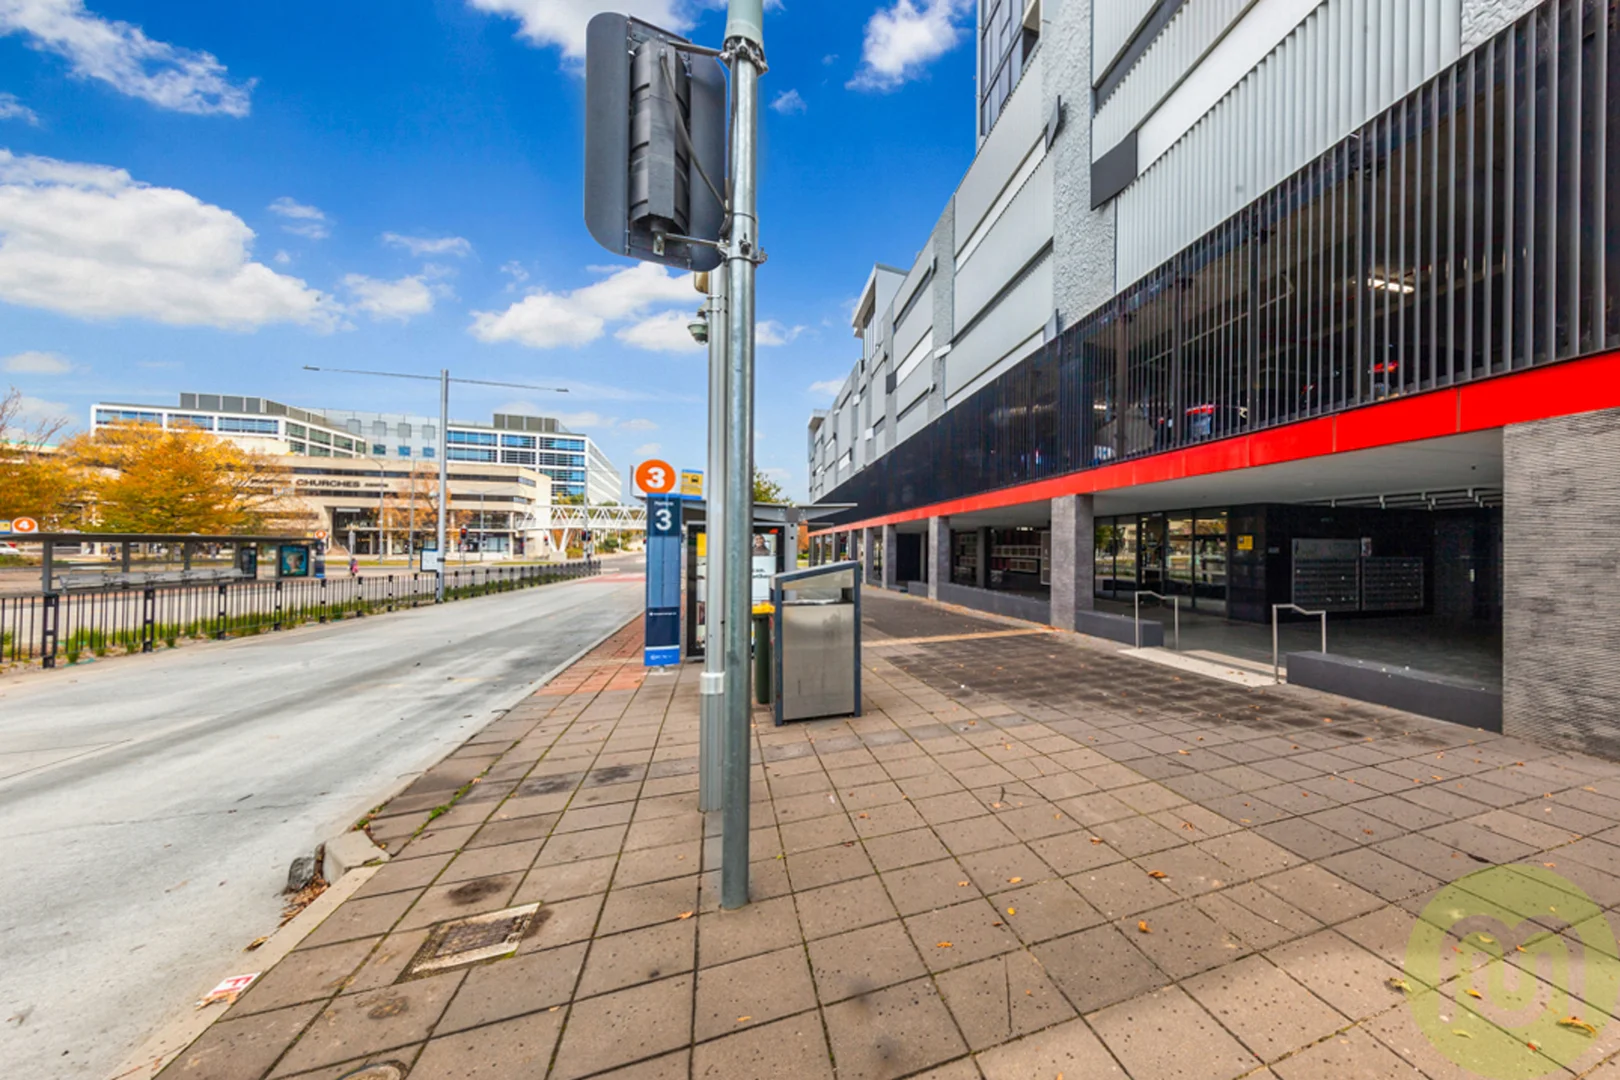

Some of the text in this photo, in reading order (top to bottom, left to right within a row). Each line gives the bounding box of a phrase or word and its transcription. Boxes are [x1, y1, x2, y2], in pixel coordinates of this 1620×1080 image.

[296, 478, 361, 488] CHURCHES
[645, 466, 666, 489] 3
[18, 520, 30, 530] 4
[655, 508, 672, 531] 3
